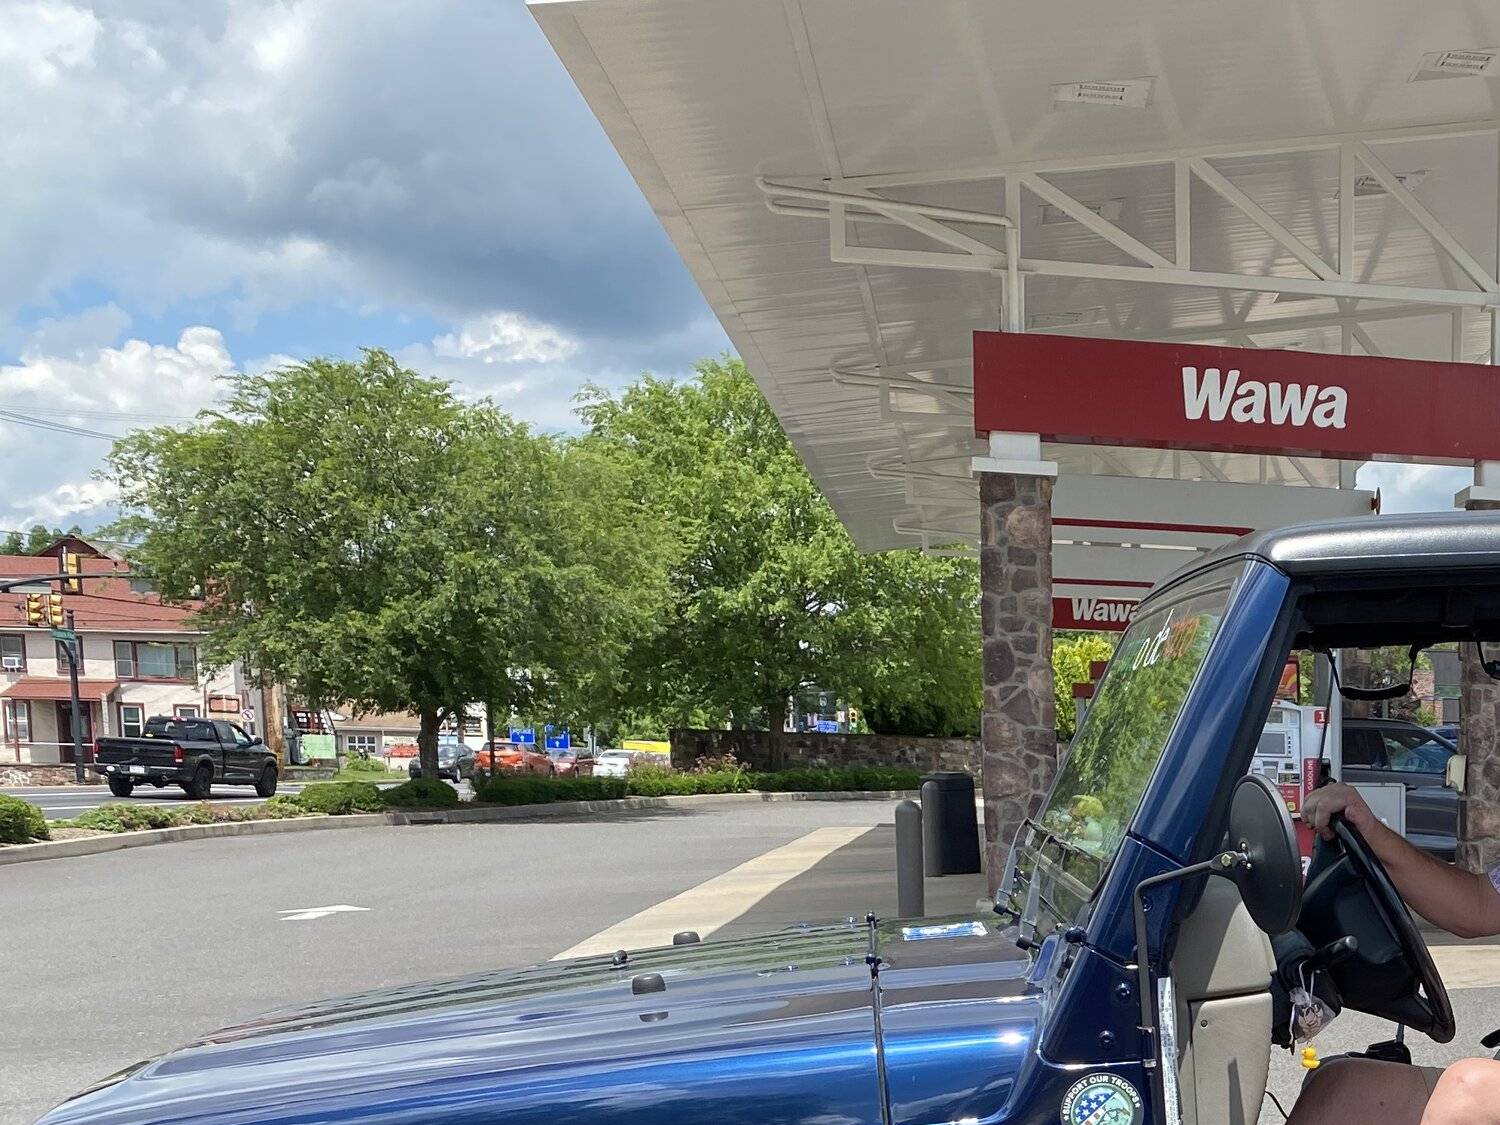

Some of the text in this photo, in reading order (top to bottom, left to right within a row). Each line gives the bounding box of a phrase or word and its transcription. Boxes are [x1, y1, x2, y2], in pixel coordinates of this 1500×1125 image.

[1181, 366, 1349, 430] Wawa
[1062, 1075, 1140, 1115] SUPPORT OUR TROOPS
